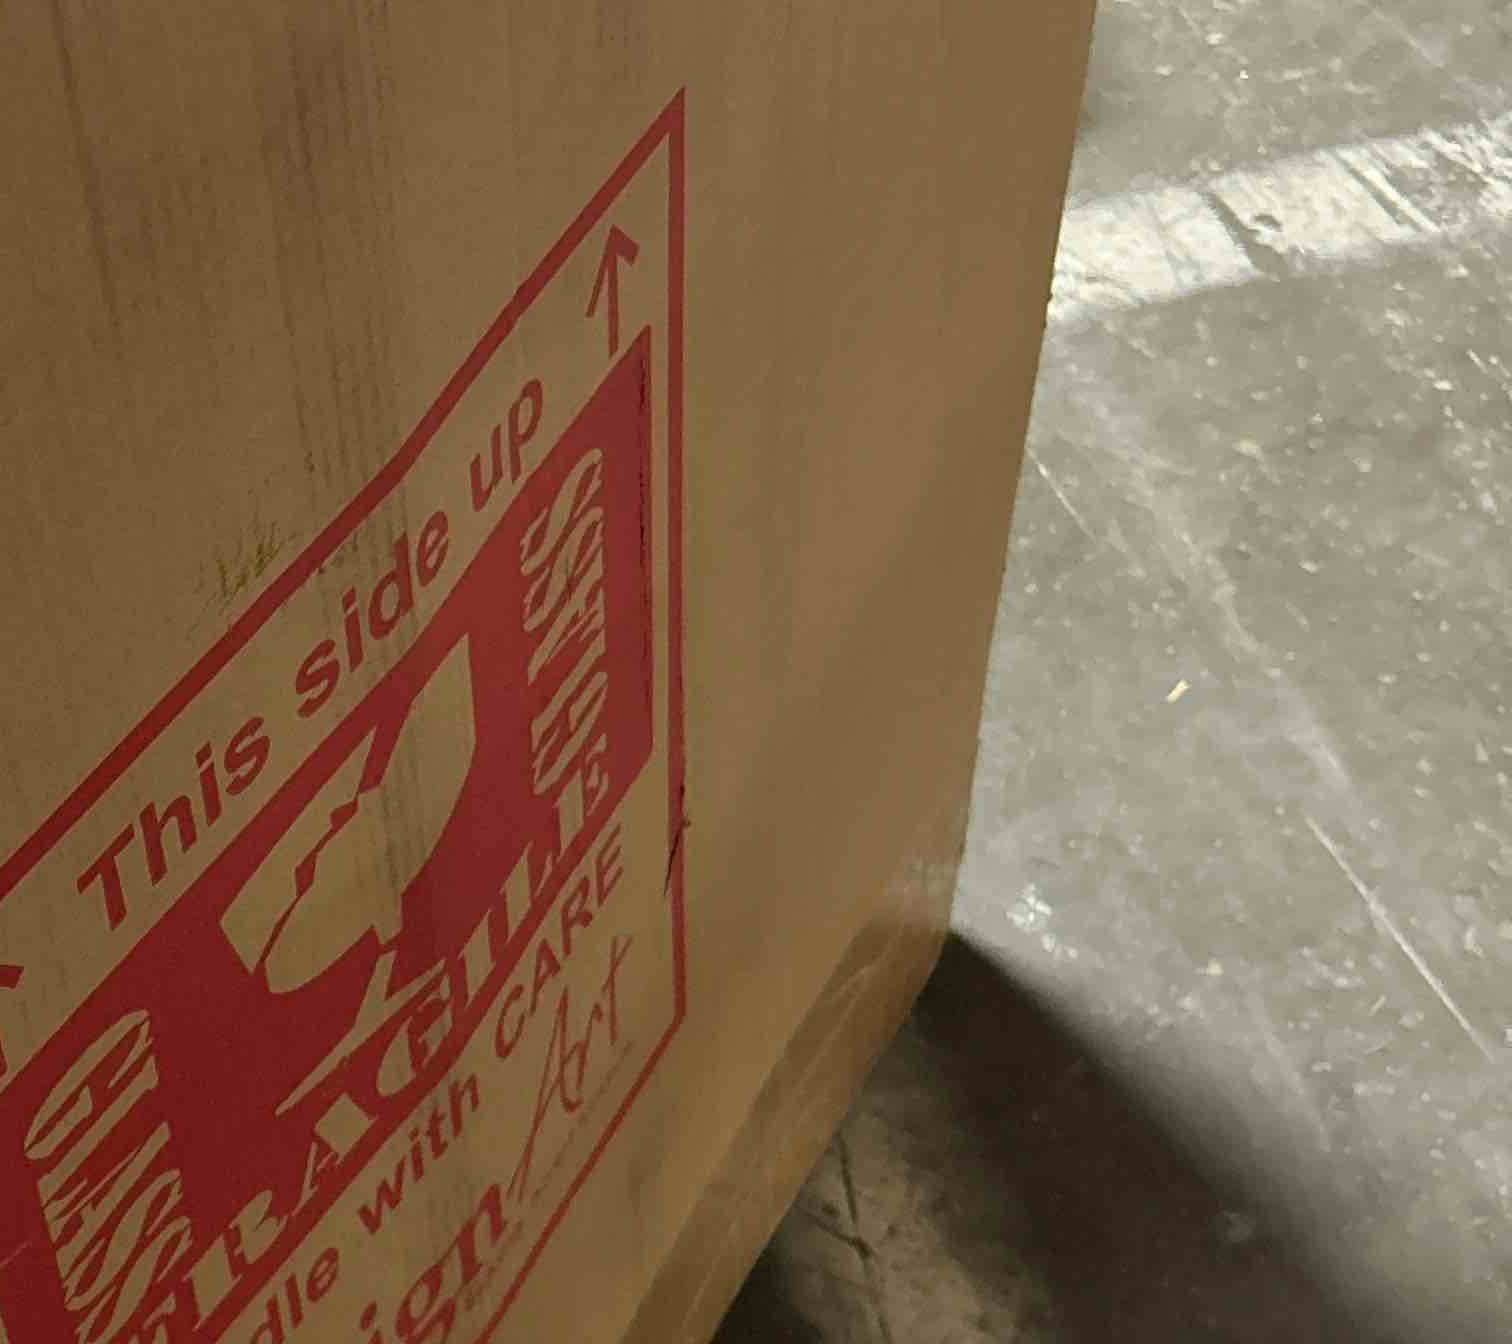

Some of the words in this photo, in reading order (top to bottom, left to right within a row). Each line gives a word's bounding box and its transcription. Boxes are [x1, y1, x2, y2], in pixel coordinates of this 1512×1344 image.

[76, 715, 272, 932] This
[295, 509, 451, 720] side
[468, 378, 544, 513] up
[519, 448, 609, 796] GLASS
[357, 1070, 482, 1238] with
[494, 822, 623, 1060] CARE
[503, 934, 635, 1204] Art
